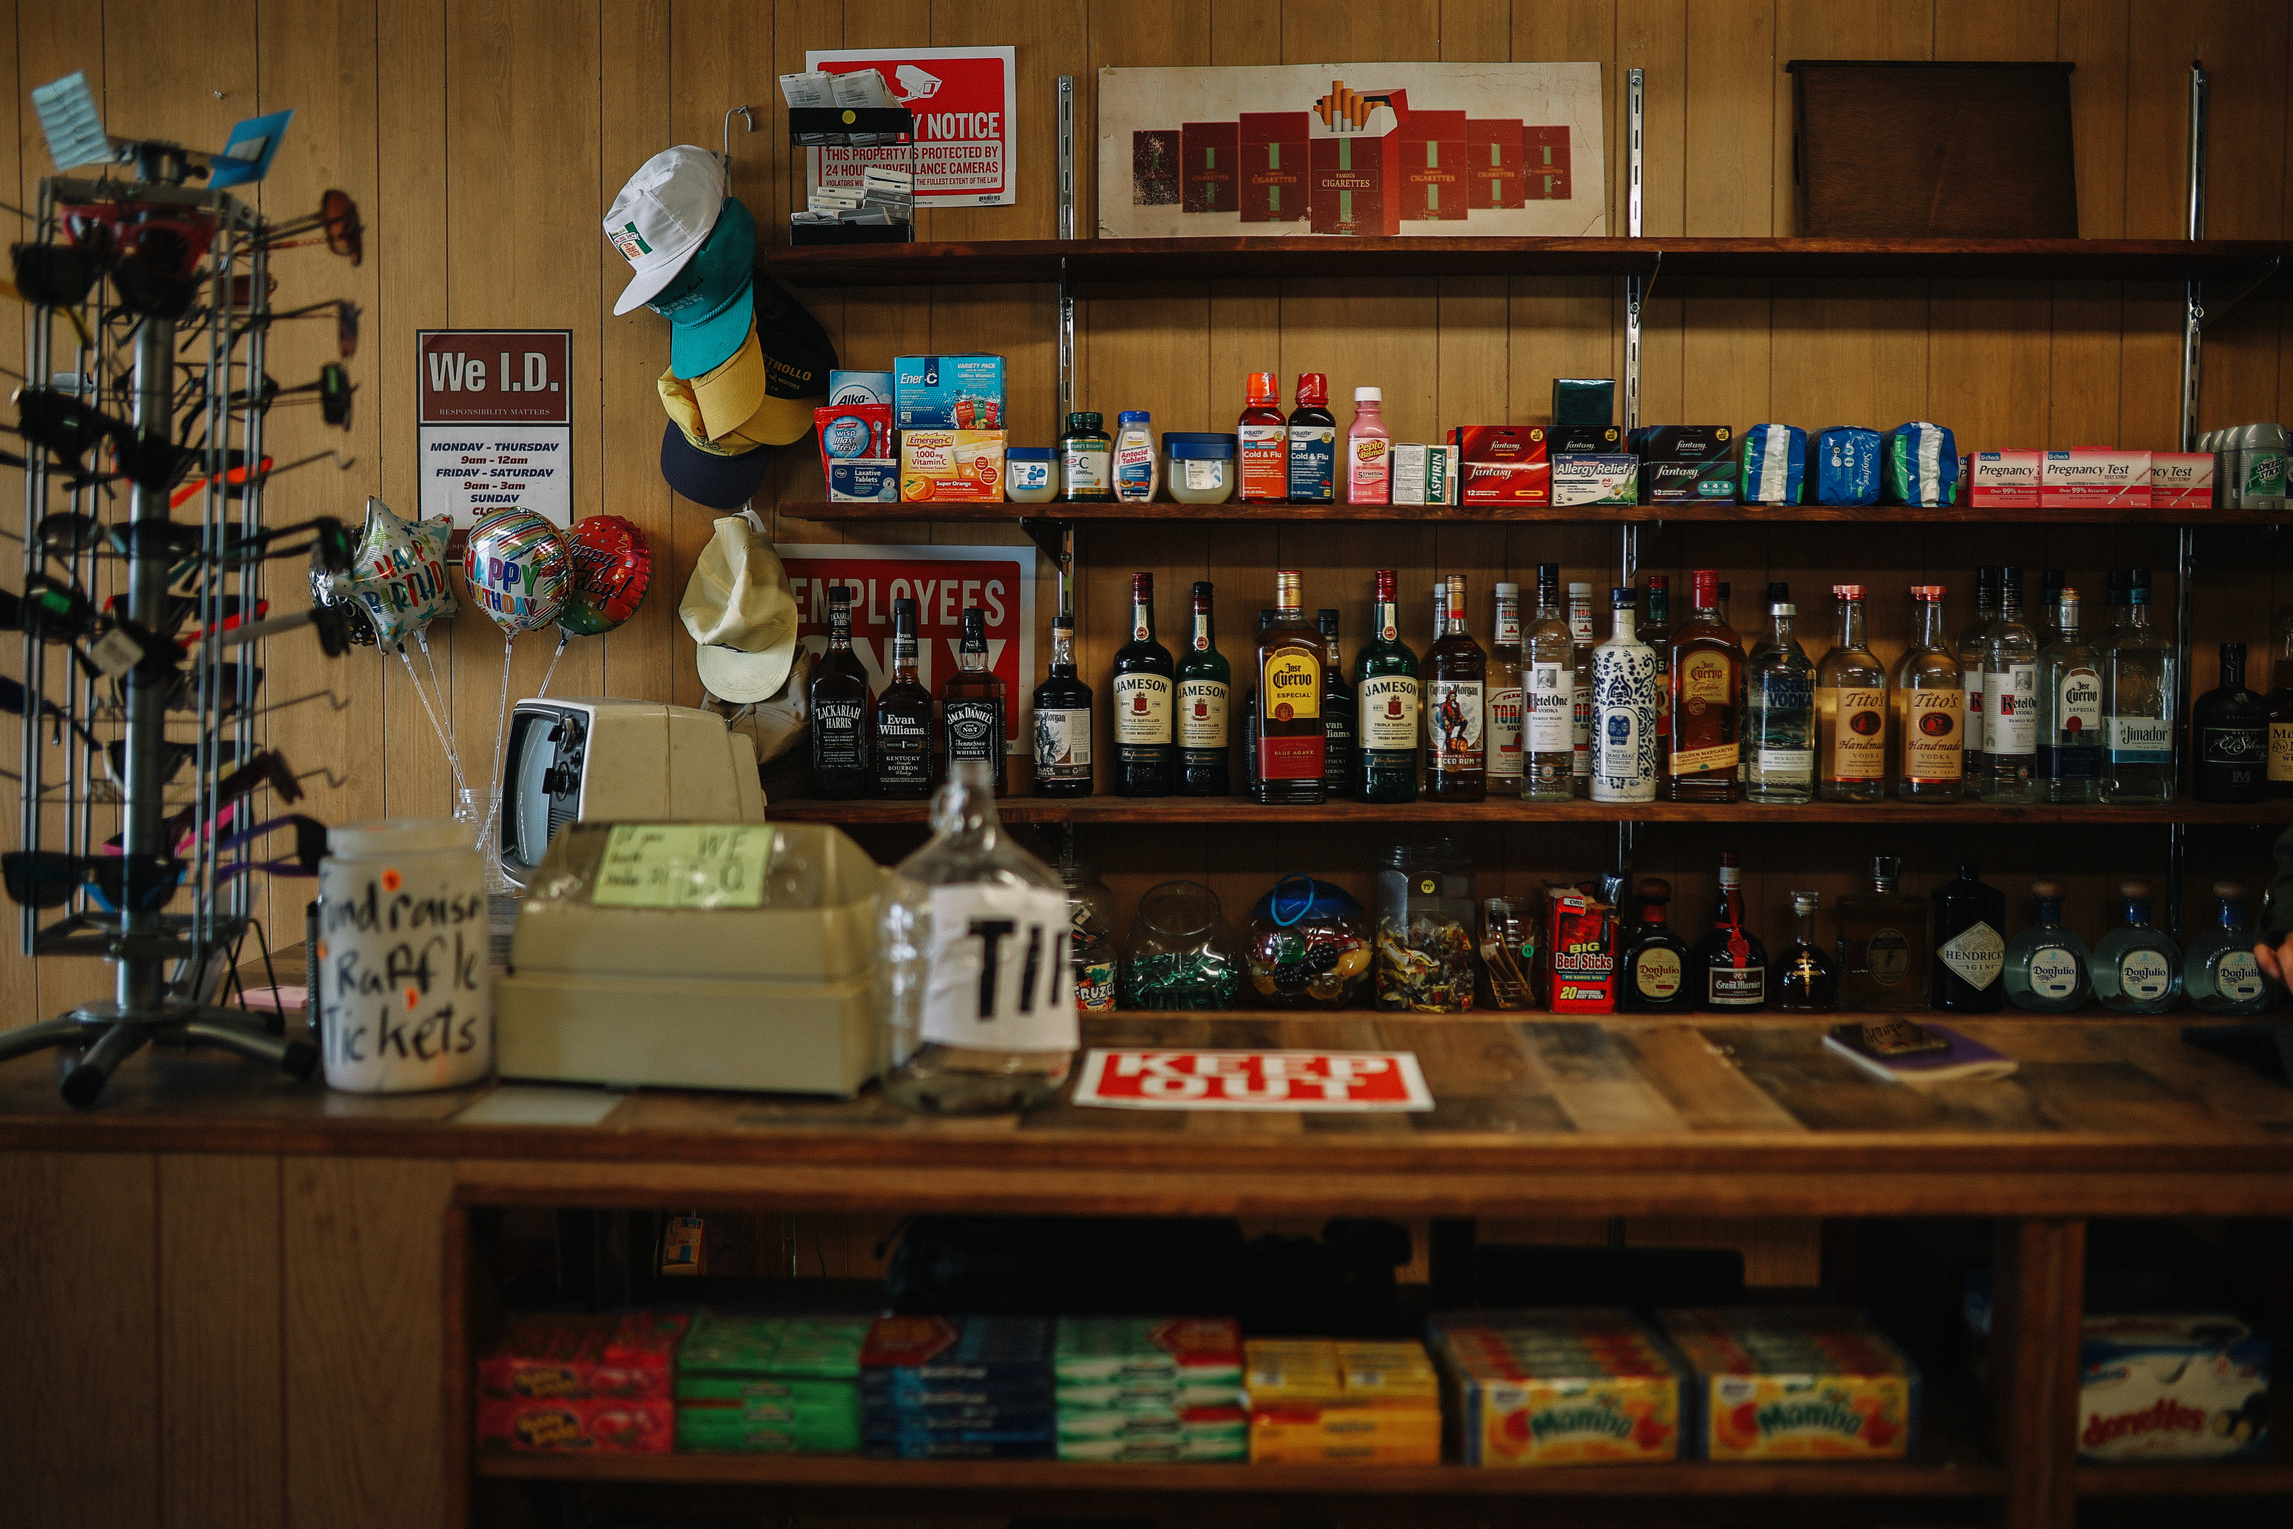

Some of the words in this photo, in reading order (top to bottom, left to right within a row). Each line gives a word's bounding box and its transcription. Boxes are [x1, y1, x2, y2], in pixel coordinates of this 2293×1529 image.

[927, 111, 1000, 139] NOTICE
[826, 148, 850, 161] THIS
[852, 147, 907, 161] PROPERTY
[921, 146, 982, 160] PROTECTED
[984, 145, 999, 159] BY
[826, 164, 839, 176] 24
[950, 161, 999, 174] CAMERAS
[826, 179, 854, 187] VIOLATORS
[916, 178, 926, 186] THE
[926, 177, 949, 186] FULLEST
[949, 177, 969, 185] EXTENT
[987, 176, 998, 184] LAW
[1252, 175, 1297, 184] CIGARETTES
[1322, 178, 1371, 188] CIGARETTES
[1410, 174, 1456, 183] CIGARETTES
[428, 352, 487, 392] We
[500, 352, 560, 392] I.D.
[900, 372, 938, 385] Ener-C
[838, 394, 870, 406] Alka-
[439, 408, 508, 416] RESPONSIBILITY
[510, 408, 551, 416] MATTERS
[836, 429, 856, 437] wisp
[1291, 430, 1312, 438] equate
[833, 437, 853, 446] Max
[909, 436, 952, 445] Emergen-C
[1489, 440, 1521, 451] fantasy
[1565, 440, 1595, 451] fantasy
[1675, 440, 1707, 451] fantasy
[430, 443, 485, 452] MONDAY
[494, 443, 559, 452] THURSDAY
[835, 444, 857, 452] Fresh
[1120, 448, 1148, 459] Antacid
[1361, 447, 1386, 460] Bismol
[460, 455, 487, 465] 9am
[497, 455, 528, 465] 12am
[911, 458, 941, 466] Vitamin
[1122, 455, 1148, 465] Tablets
[1291, 452, 1309, 460] Cold
[1079, 456, 1089, 469] C
[2257, 459, 2281, 473] SPEED
[436, 468, 480, 478] FRIDAY
[490, 468, 554, 478] SATURDAY
[854, 469, 881, 477] Laxative
[1431, 452, 1443, 498] ASPIRIN
[1469, 465, 1512, 480] fantasy
[1556, 463, 1596, 477] Allergy
[1596, 463, 1629, 474] Relief
[1655, 464, 1700, 480] fantasy
[1862, 451, 1874, 487] Stayfree
[1979, 465, 2035, 477] Pregnancy
[2047, 464, 2104, 477] Pregnancy
[2107, 464, 2130, 474] Test
[2170, 466, 2193, 477] Test
[2259, 467, 2280, 480] STICK
[463, 481, 490, 491] 9am
[500, 481, 526, 491] 3am
[951, 480, 972, 488] Orange
[2002, 487, 2017, 495] 99%
[470, 494, 520, 503] SUNDAY
[374, 534, 436, 580] HAPPY
[464, 547, 540, 597] HAPPY
[361, 560, 445, 613] BIRTHD
[1285, 663, 1302, 674] Jose
[1691, 667, 1723, 680] Cuervo
[1273, 670, 1312, 689] Cuervo
[1116, 678, 1169, 694] JAMESON
[1365, 681, 1418, 697] JAMESON
[1453, 684, 1479, 697] Morgan
[2076, 681, 2090, 691] Jose
[1177, 685, 1227, 700] JAMESON
[2066, 687, 2098, 704] Cuervo
[1552, 694, 1568, 707] One
[1846, 692, 1884, 709] Tito's
[1914, 692, 1957, 709] Tito's
[2001, 694, 2028, 715] Ketel
[815, 704, 862, 720] ZACKARIAH
[947, 709, 965, 725] JACK
[964, 706, 995, 725] DANIEL'S
[826, 717, 852, 729] HARRIS
[886, 714, 916, 725] Evan
[879, 724, 926, 735] Williams
[2122, 725, 2168, 745] Jimador
[1908, 739, 1962, 751] Handmade
[1700, 747, 1734, 756] MARGARITA
[1569, 942, 1600, 954] BIG
[1556, 952, 1581, 970] Beef
[1581, 952, 1614, 971] Sticks
[1945, 950, 2005, 961] HENDRICK
[1972, 963, 1991, 971] GIN
[1715, 980, 1738, 990] Grand
[1737, 979, 1761, 989] Marnier
[1560, 986, 1576, 1000] 20
[326, 1002, 477, 1063] Tickets
[1114, 1053, 1391, 1080] KEEP
[1138, 1075, 1358, 1099] OUT
[1529, 1405, 1635, 1442] Mamba
[1757, 1402, 1865, 1438] Mamba
